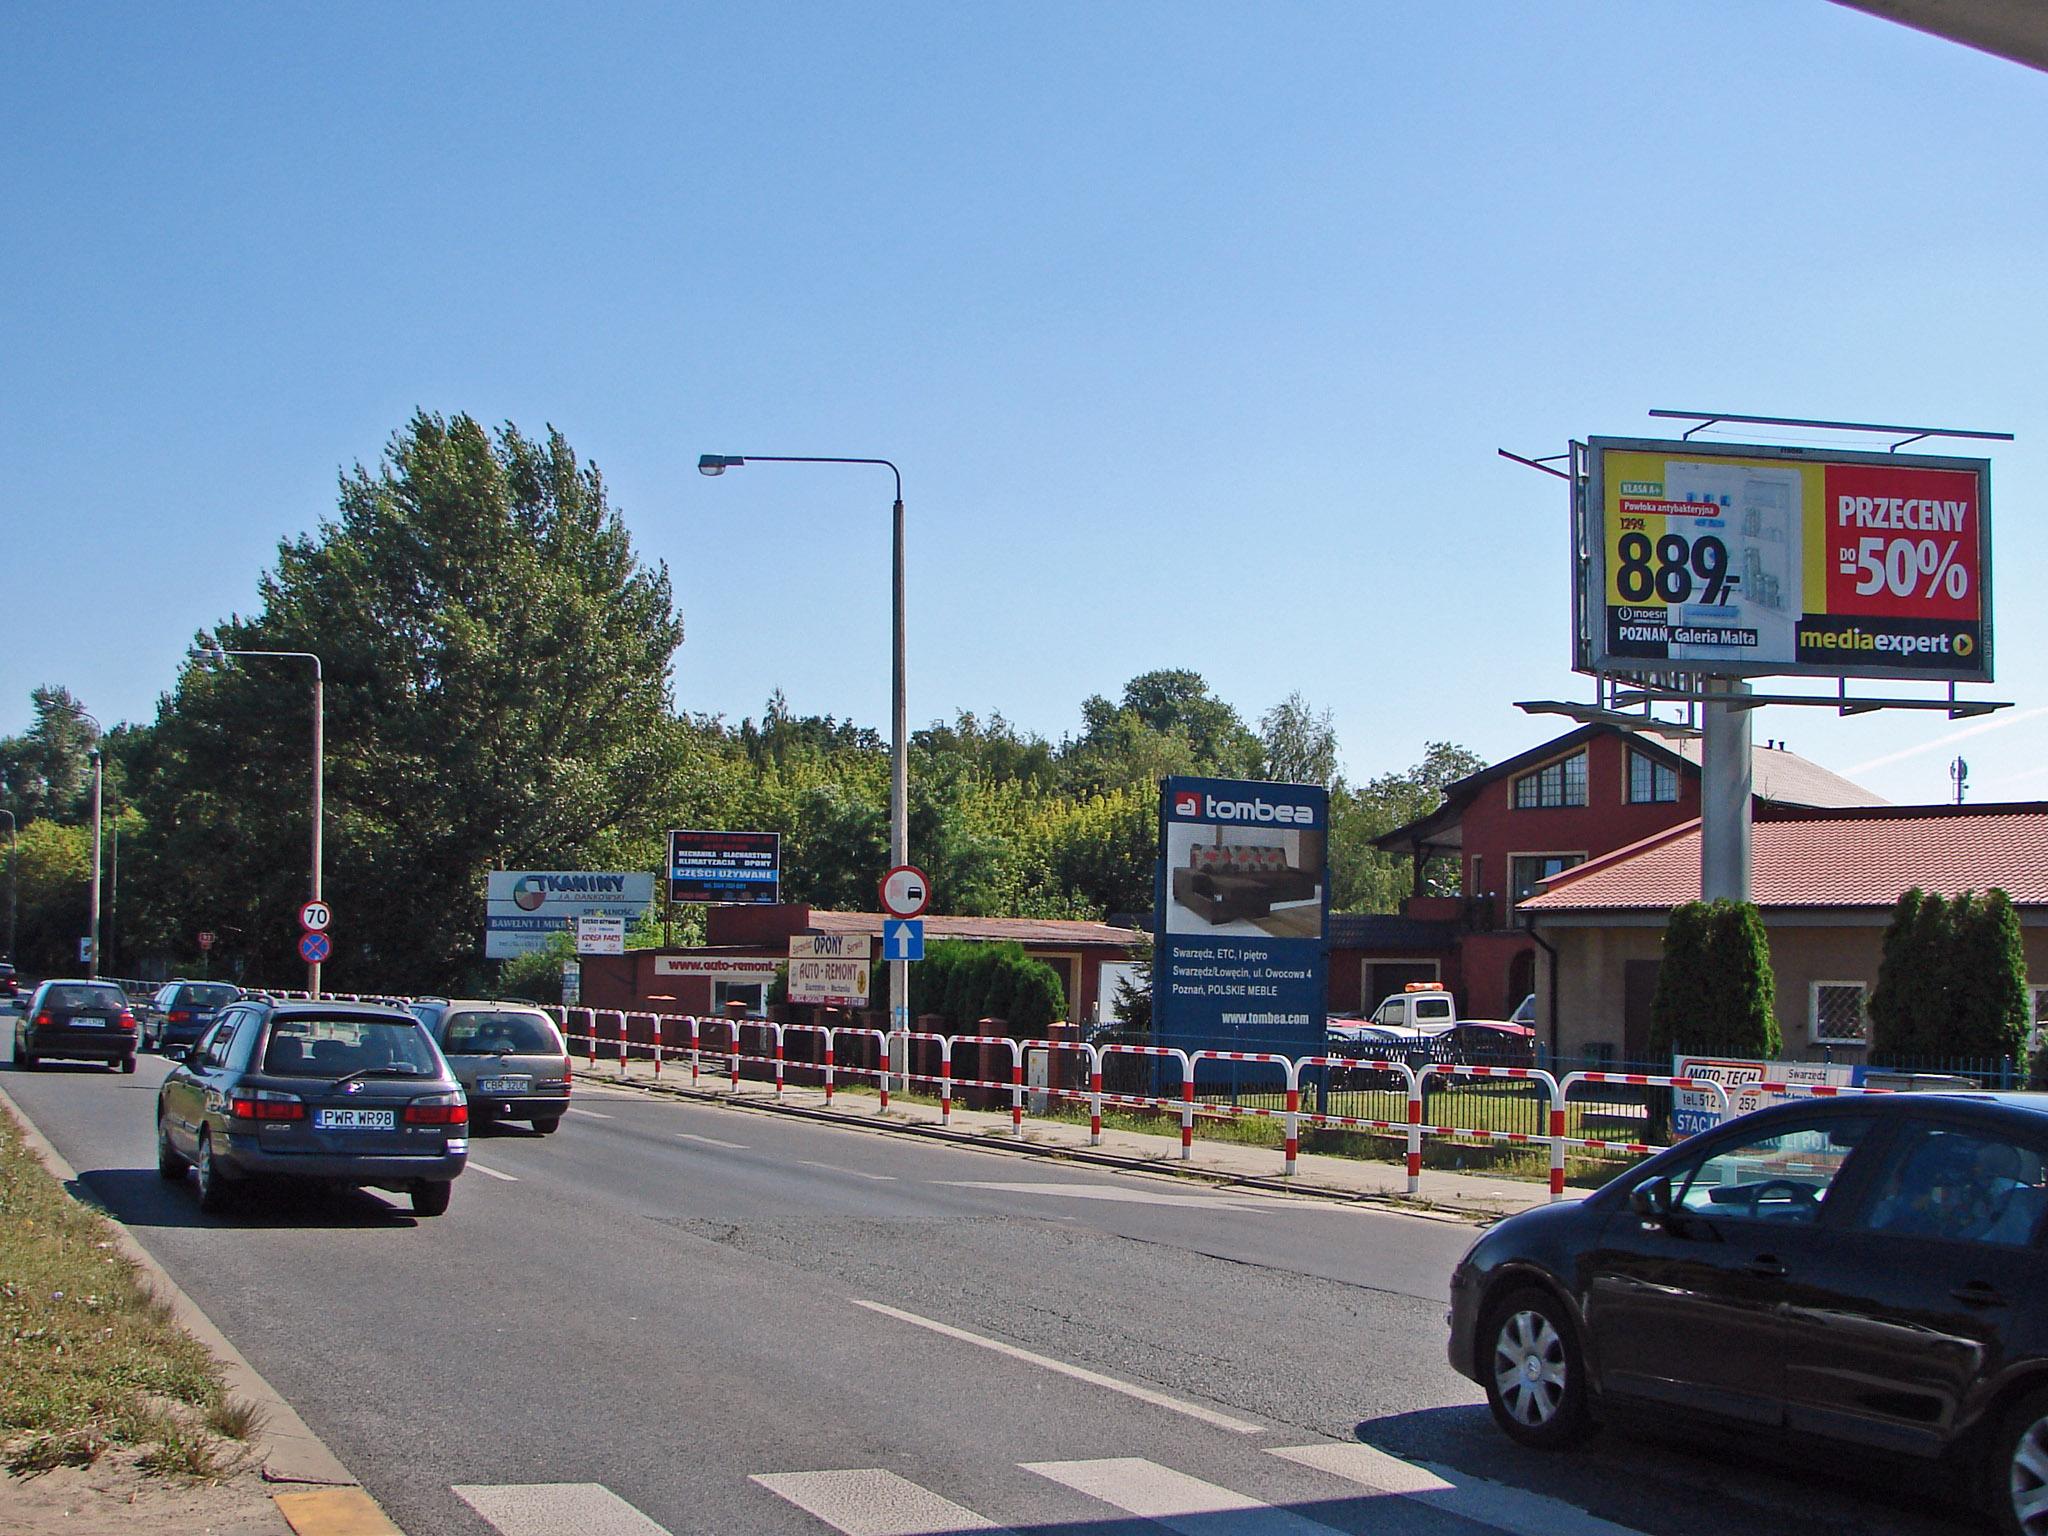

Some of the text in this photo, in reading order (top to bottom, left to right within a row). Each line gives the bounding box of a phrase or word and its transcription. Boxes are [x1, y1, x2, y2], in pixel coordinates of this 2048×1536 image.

[1657, 503, 1714, 516] antybakteryjna
[1838, 496, 1967, 532] PRZECENY
[1840, 547, 1856, 561] DO
[1619, 625, 1756, 645] POZNAŃ, Galeria Malta
[1800, 628, 1949, 656] mediaexpert
[1206, 794, 1314, 824] tombea
[679, 858, 736, 866] KLIMATYZACJA
[677, 868, 772, 879] CZĘŚCI UŻYWANE
[536, 875, 625, 893] TKANINY
[307, 909, 327, 924] 70
[491, 919, 534, 928] BAWEŁNY
[814, 936, 843, 955] OPONY
[1173, 947, 1215, 960] Swarzędz,
[1217, 949, 1237, 960] ETC,
[1243, 949, 1268, 962] piętro
[799, 963, 858, 981] AUTO REMONT
[1253, 968, 1263, 978] ul.
[1265, 968, 1305, 979] Owocowa
[1306, 968, 1312, 978] 4
[1172, 984, 1278, 996] Poznań, POLSKIE MEBLE
[1222, 1012, 1309, 1025] www.tombea.com
[1683, 1093, 1756, 1110] tel. 512 252
[324, 1111, 392, 1126] PWR WR98
